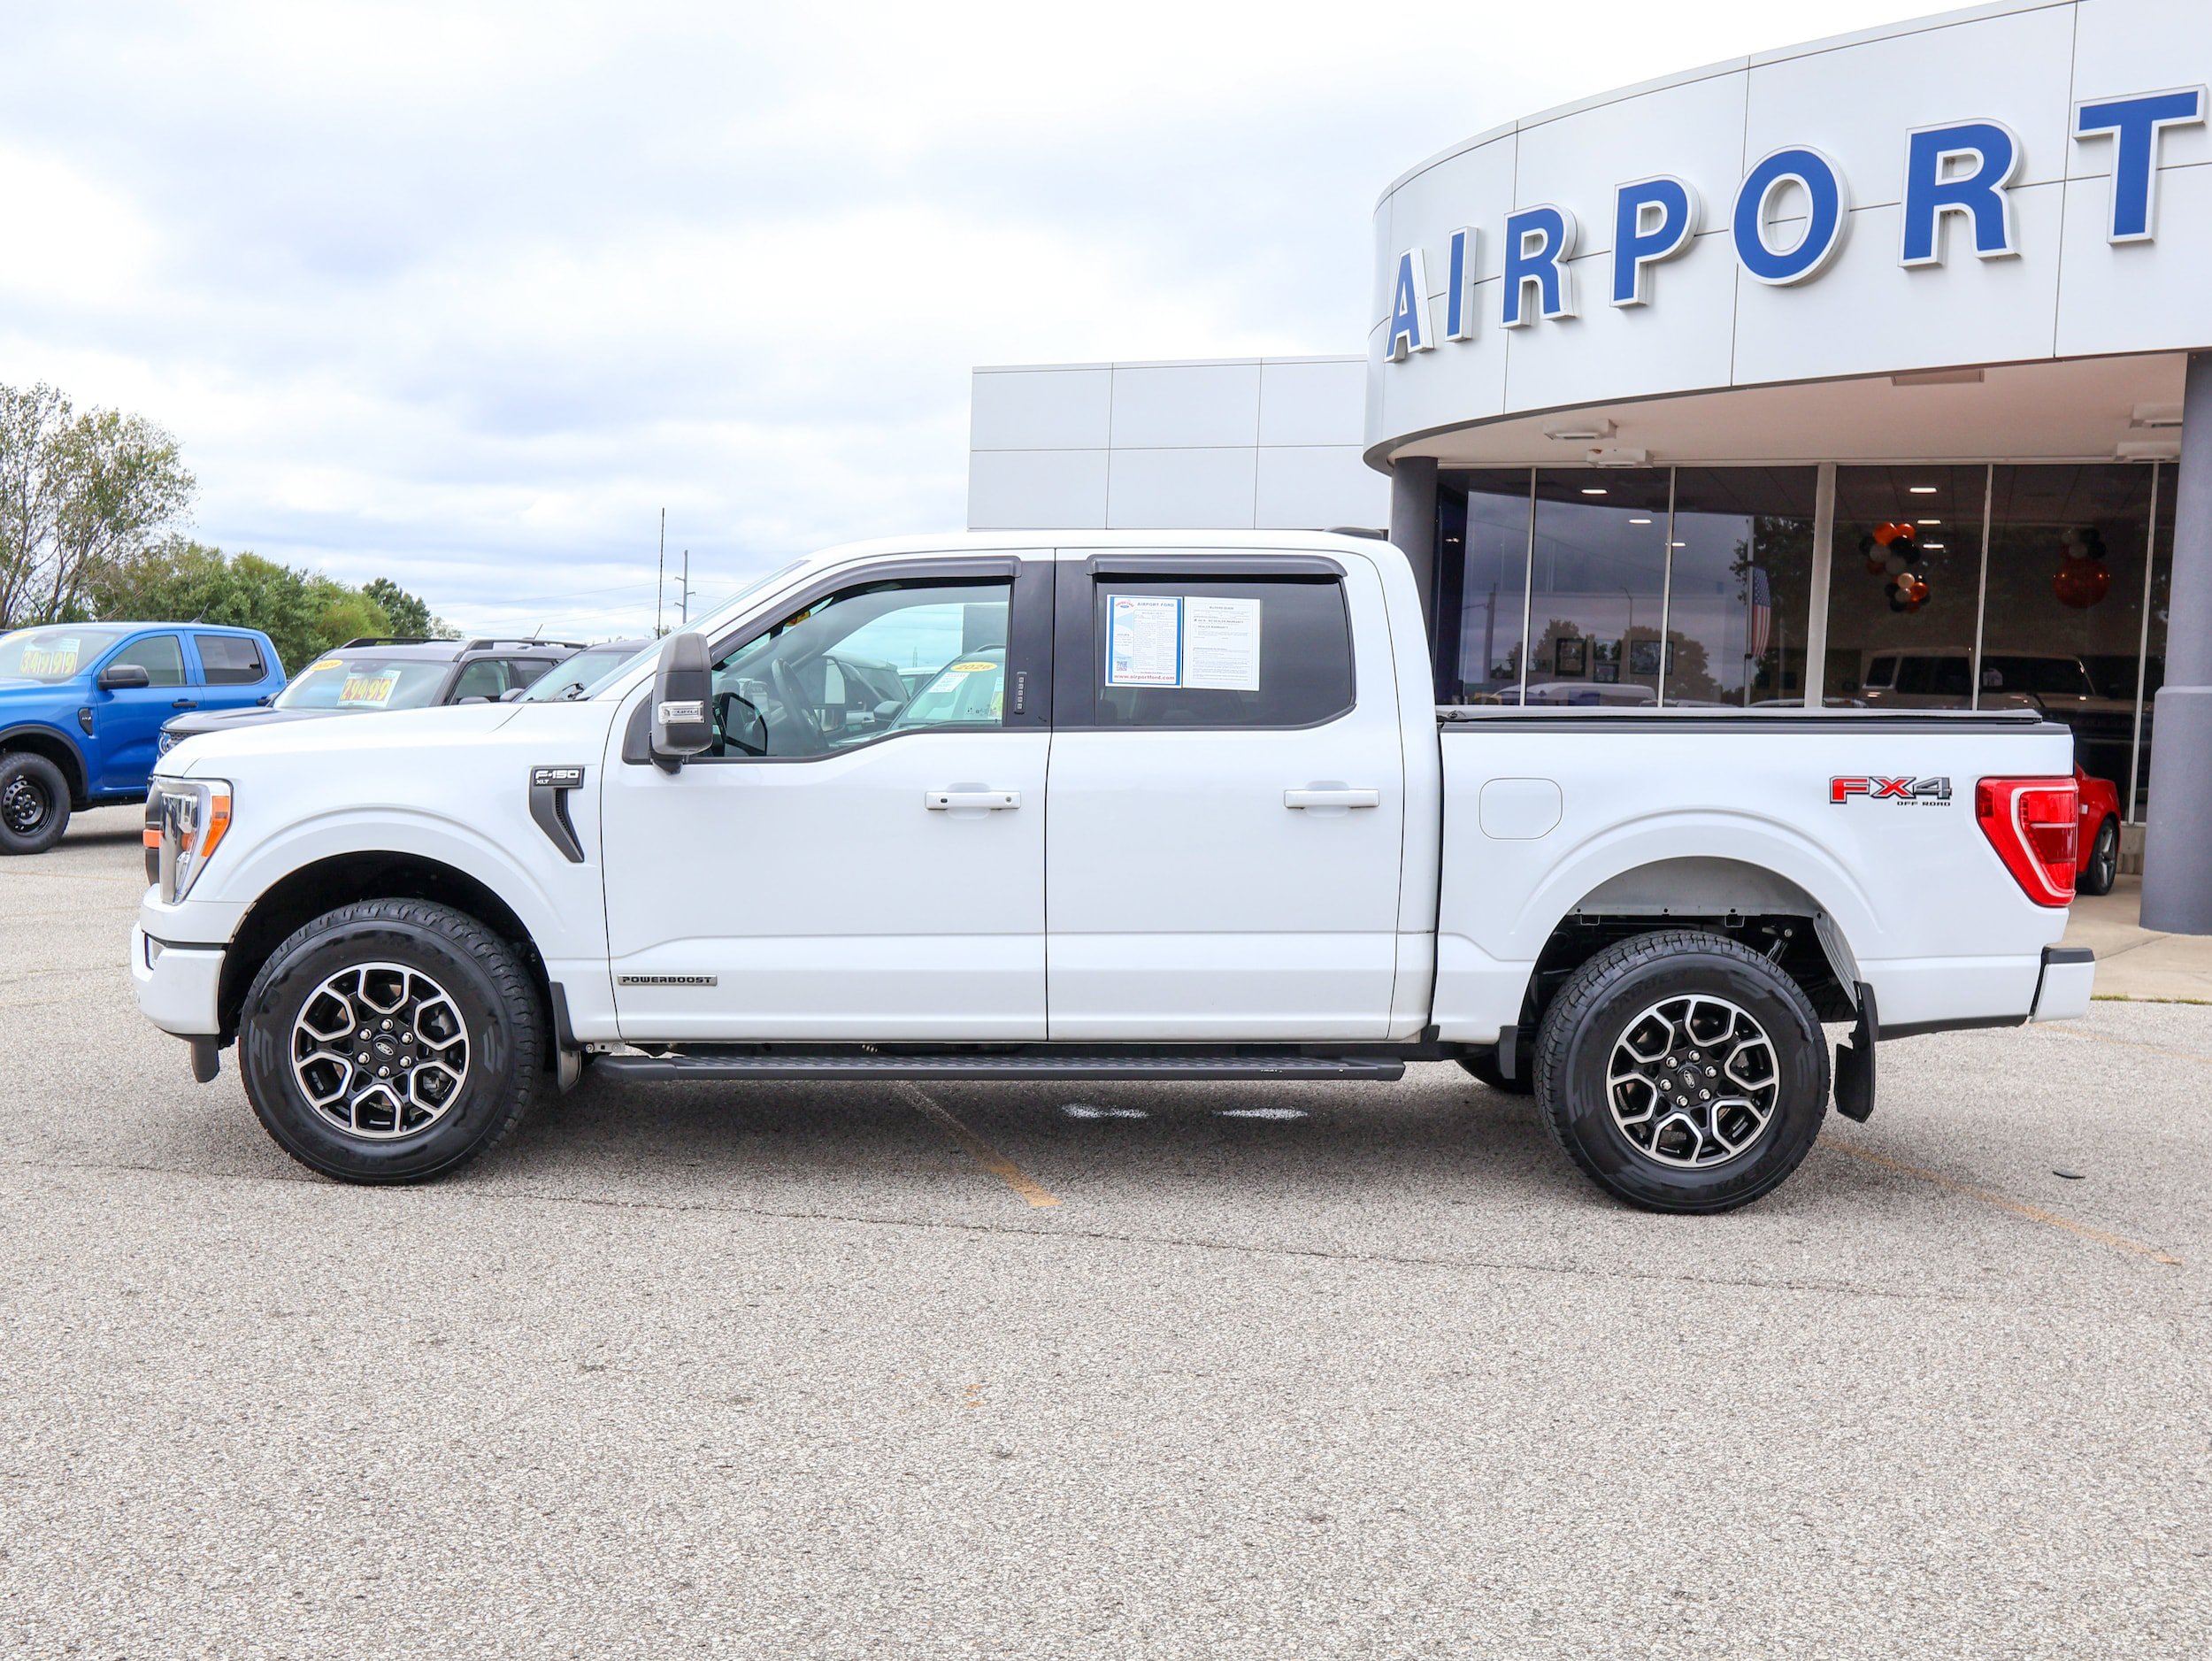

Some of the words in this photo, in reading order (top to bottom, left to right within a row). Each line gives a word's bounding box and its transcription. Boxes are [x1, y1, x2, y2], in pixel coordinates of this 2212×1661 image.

[1384, 82, 2207, 364] AIRPORT
[20, 650, 76, 673] 34999
[339, 677, 393, 701] 29499
[535, 769, 580, 780] F-150
[1829, 775, 1952, 804] FX4
